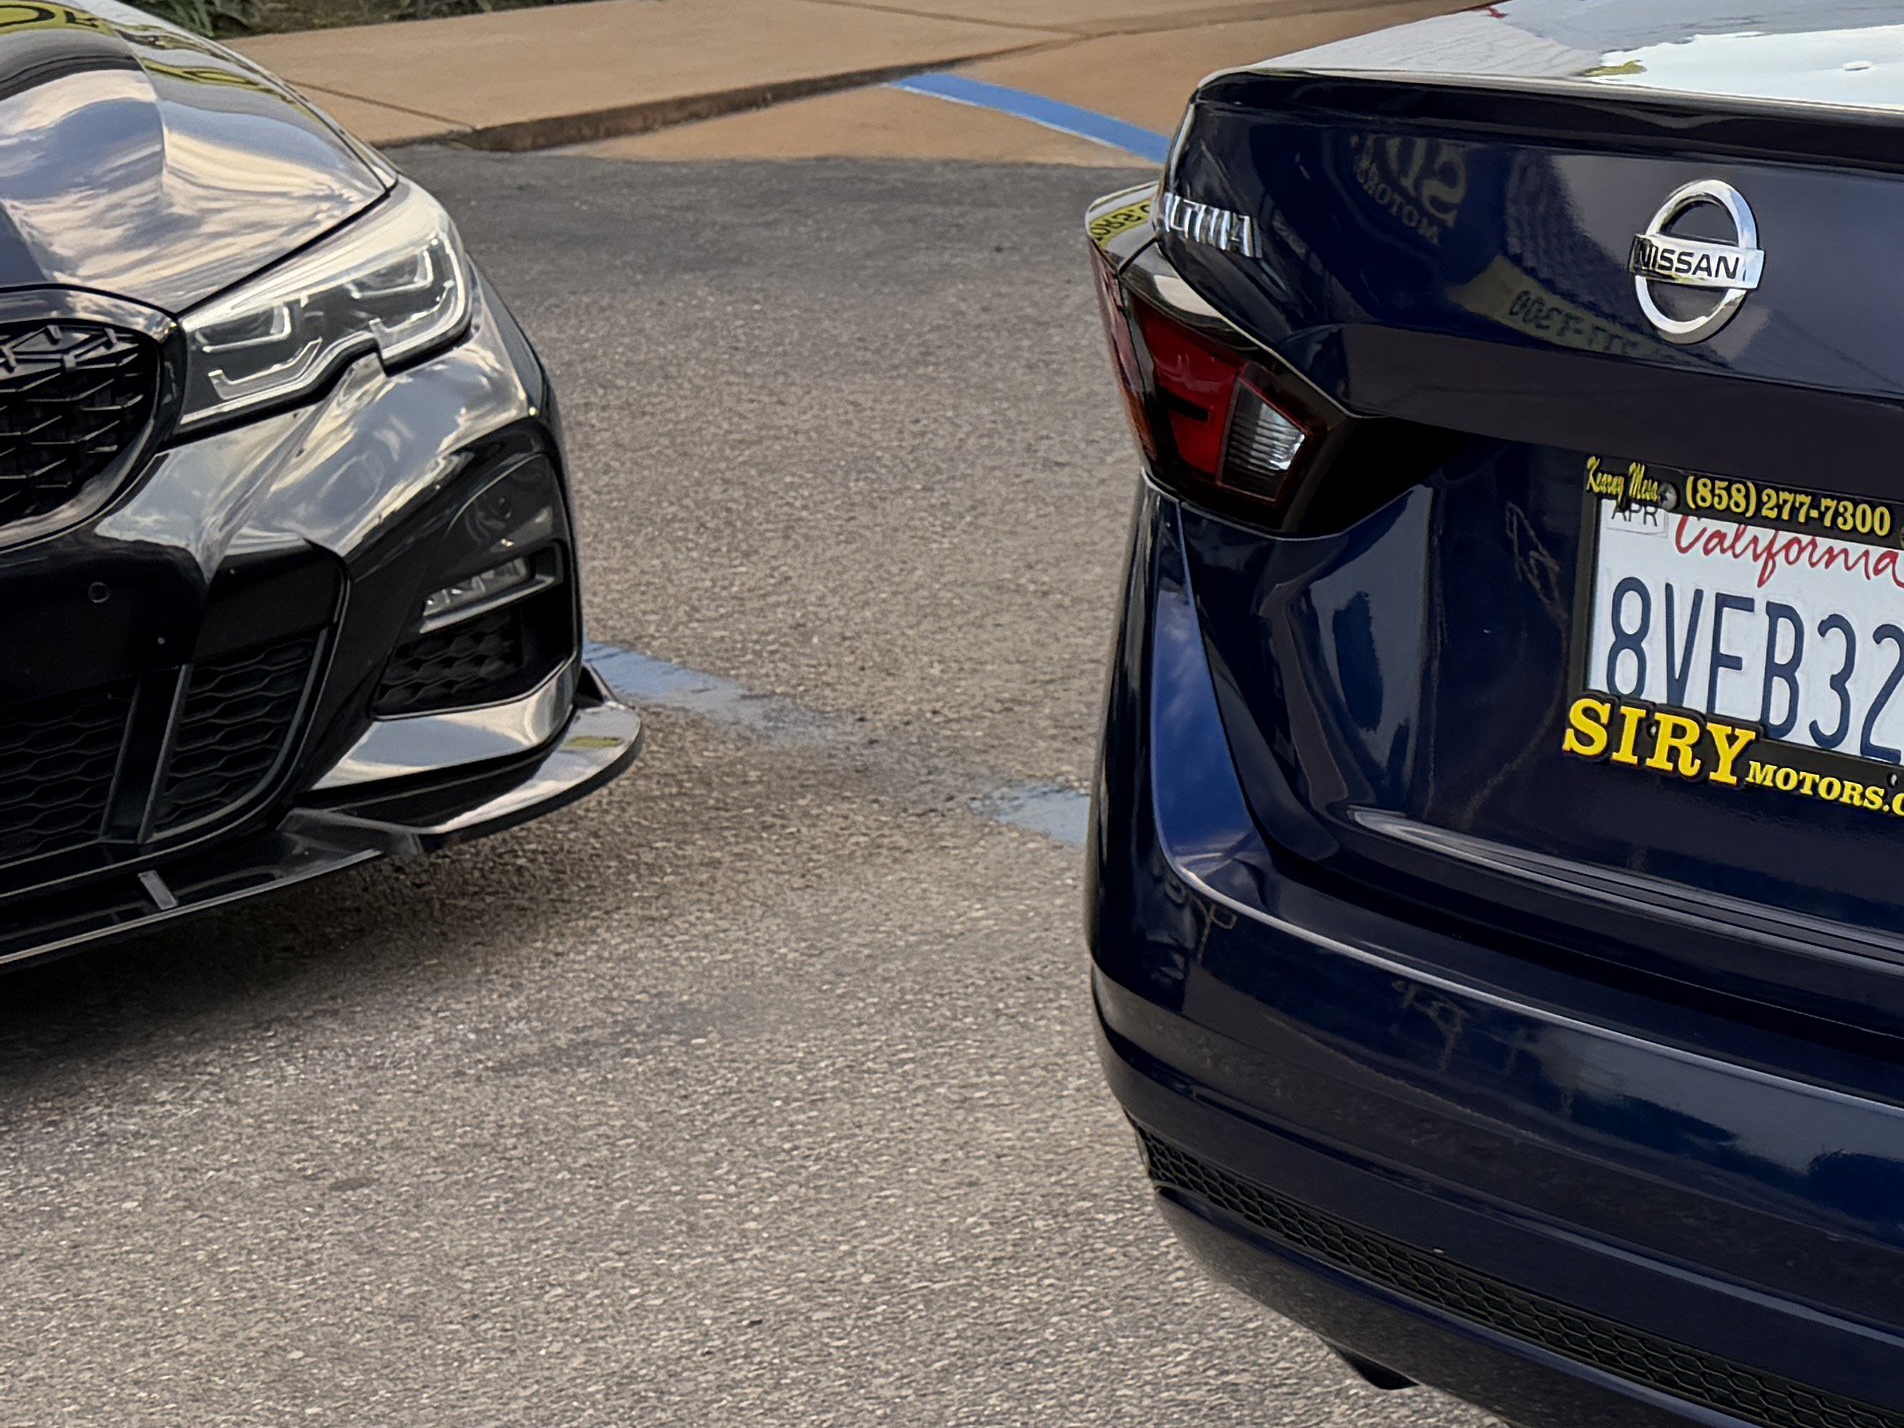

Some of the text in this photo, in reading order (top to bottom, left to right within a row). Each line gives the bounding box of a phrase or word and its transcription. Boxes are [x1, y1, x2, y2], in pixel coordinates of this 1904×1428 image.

[1637, 241, 1741, 281] NISSAN
[1611, 504, 1659, 527] APR
[1686, 476, 1891, 537] (858) 277-7300
[1562, 696, 1757, 785] SIRY
